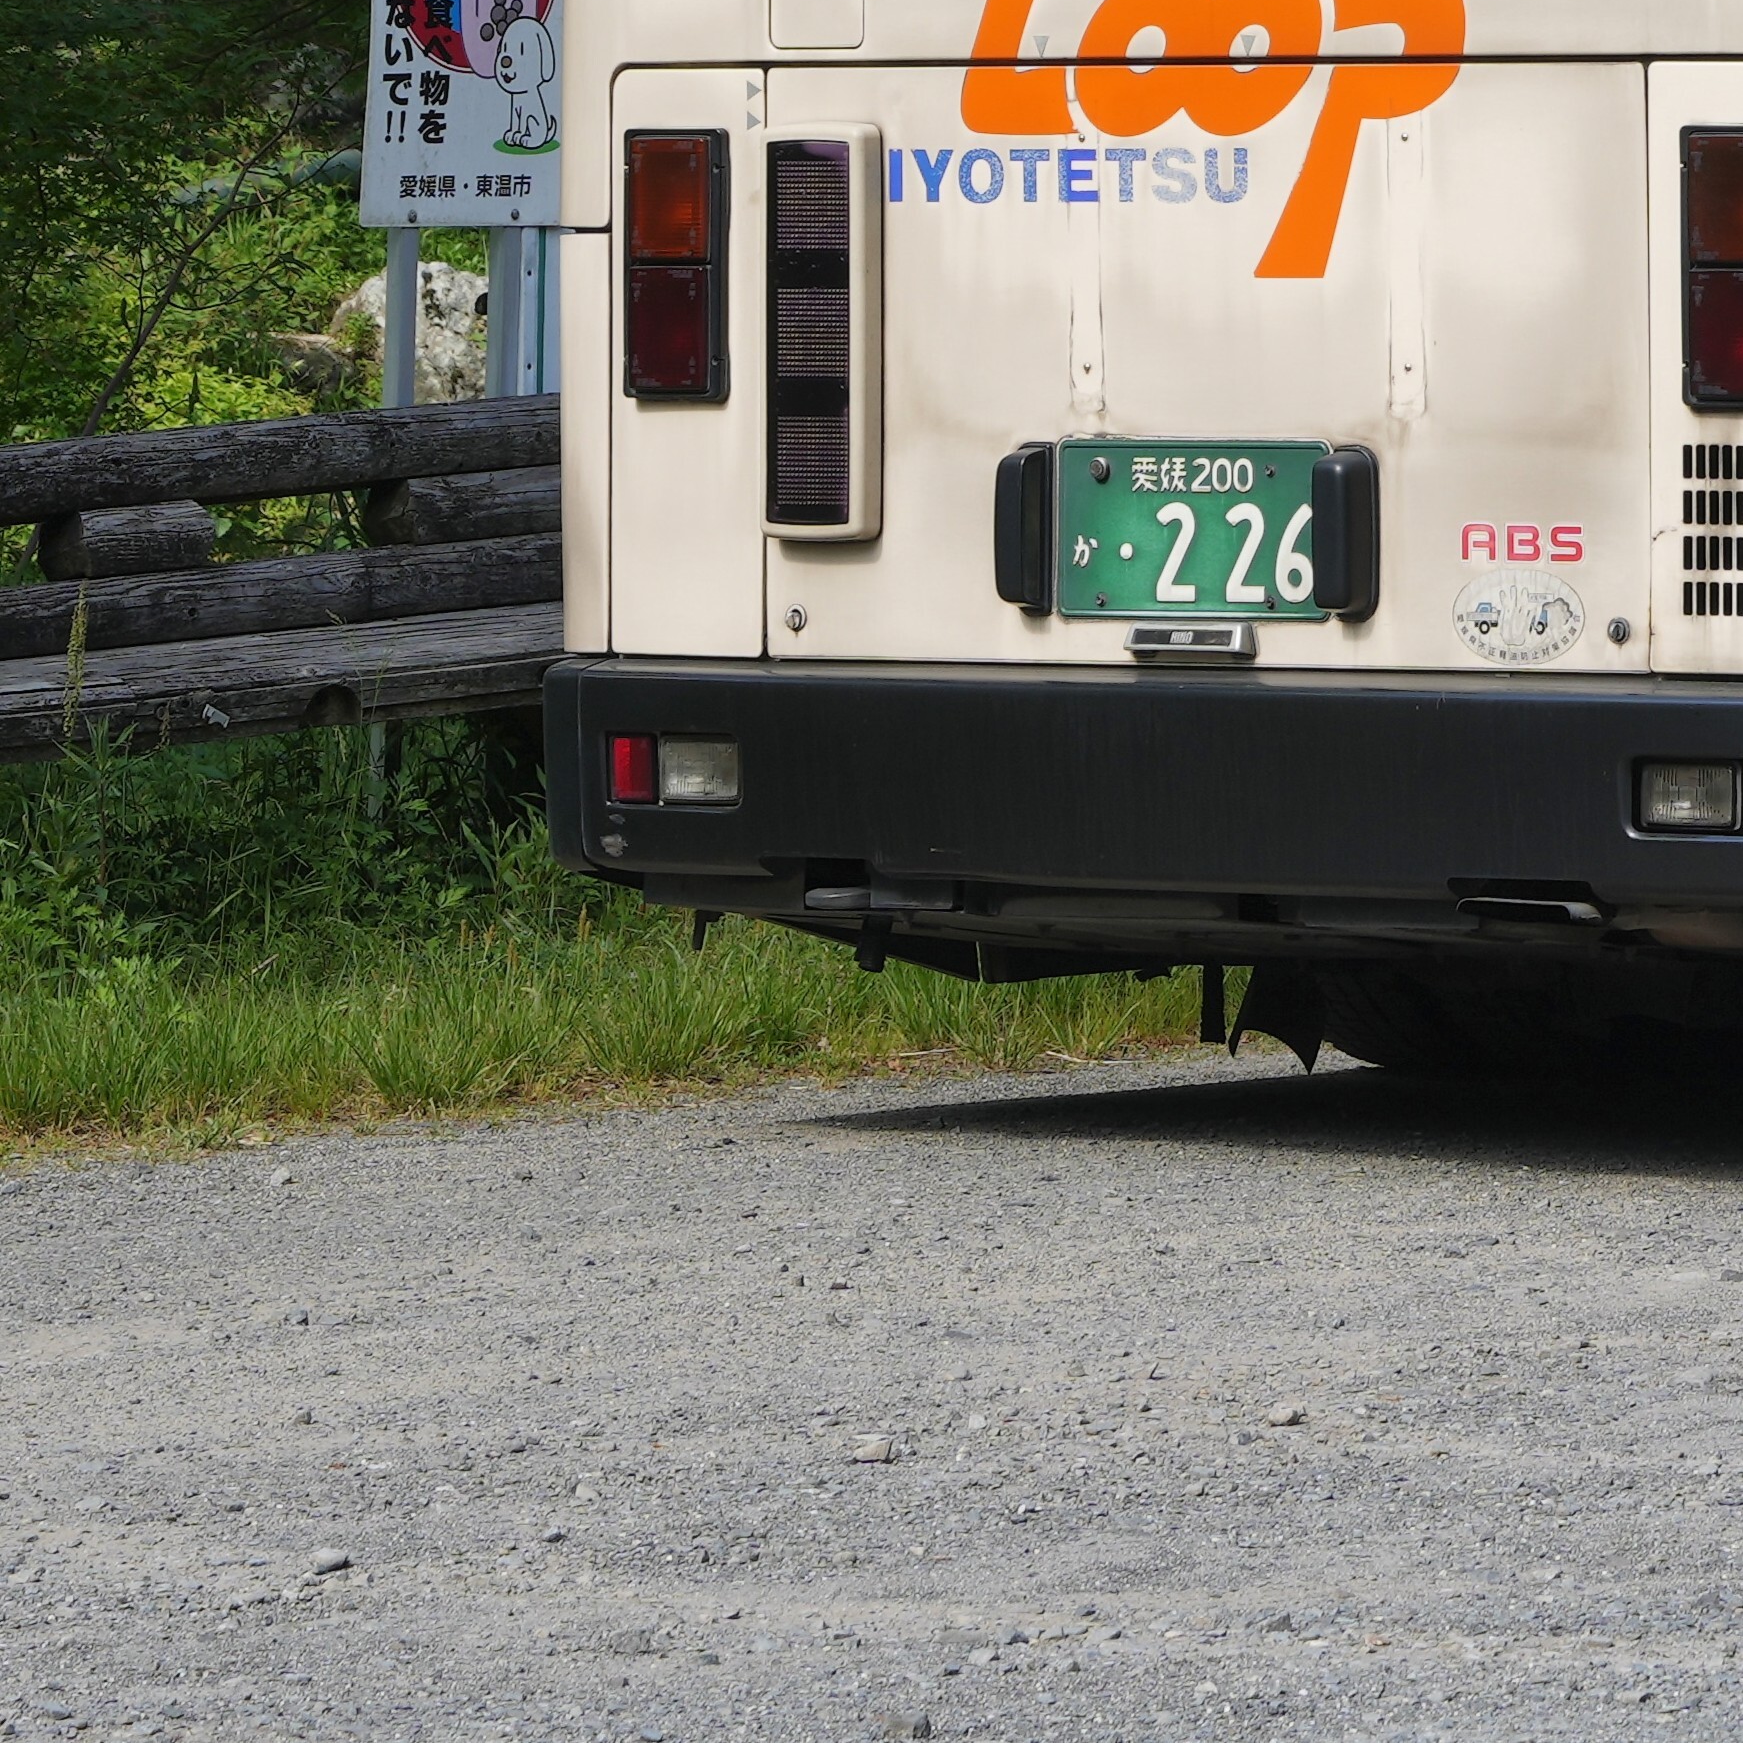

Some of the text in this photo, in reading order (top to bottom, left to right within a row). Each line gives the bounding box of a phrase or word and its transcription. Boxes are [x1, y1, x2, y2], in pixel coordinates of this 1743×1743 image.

[399, 173, 532, 200] 愛媛県・東温市
[888, 147, 1250, 204] IYOTETSU
[1073, 533, 1098, 568] か
[1460, 523, 1584, 562] ABS
[1169, 630, 1194, 644] HINO
